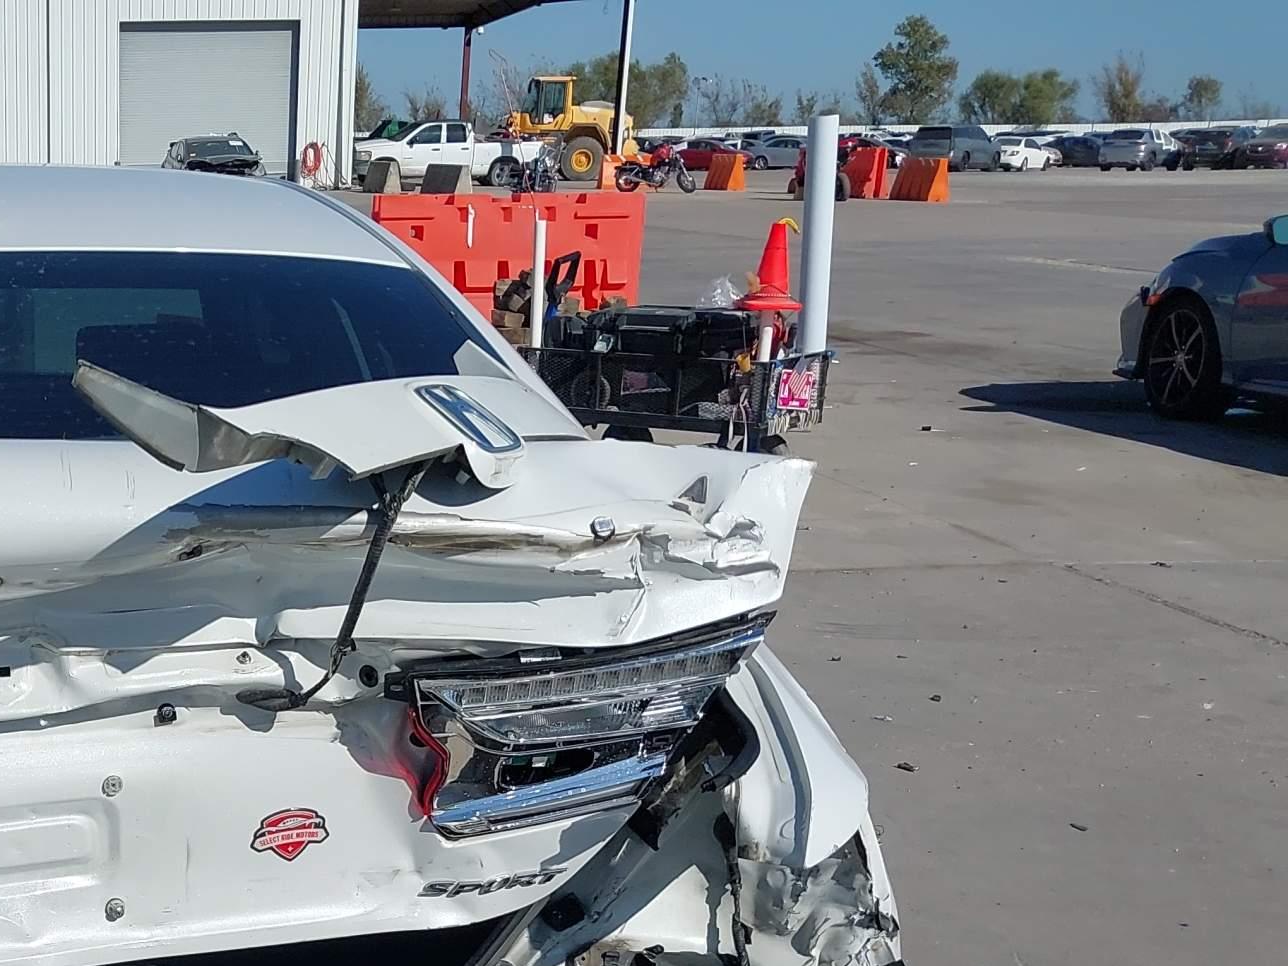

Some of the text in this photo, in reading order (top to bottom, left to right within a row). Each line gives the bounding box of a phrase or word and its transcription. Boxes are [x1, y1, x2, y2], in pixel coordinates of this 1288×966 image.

[259, 835, 280, 847] SELECT
[296, 831, 319, 839] MOTORS
[417, 867, 568, 898] SPORT
